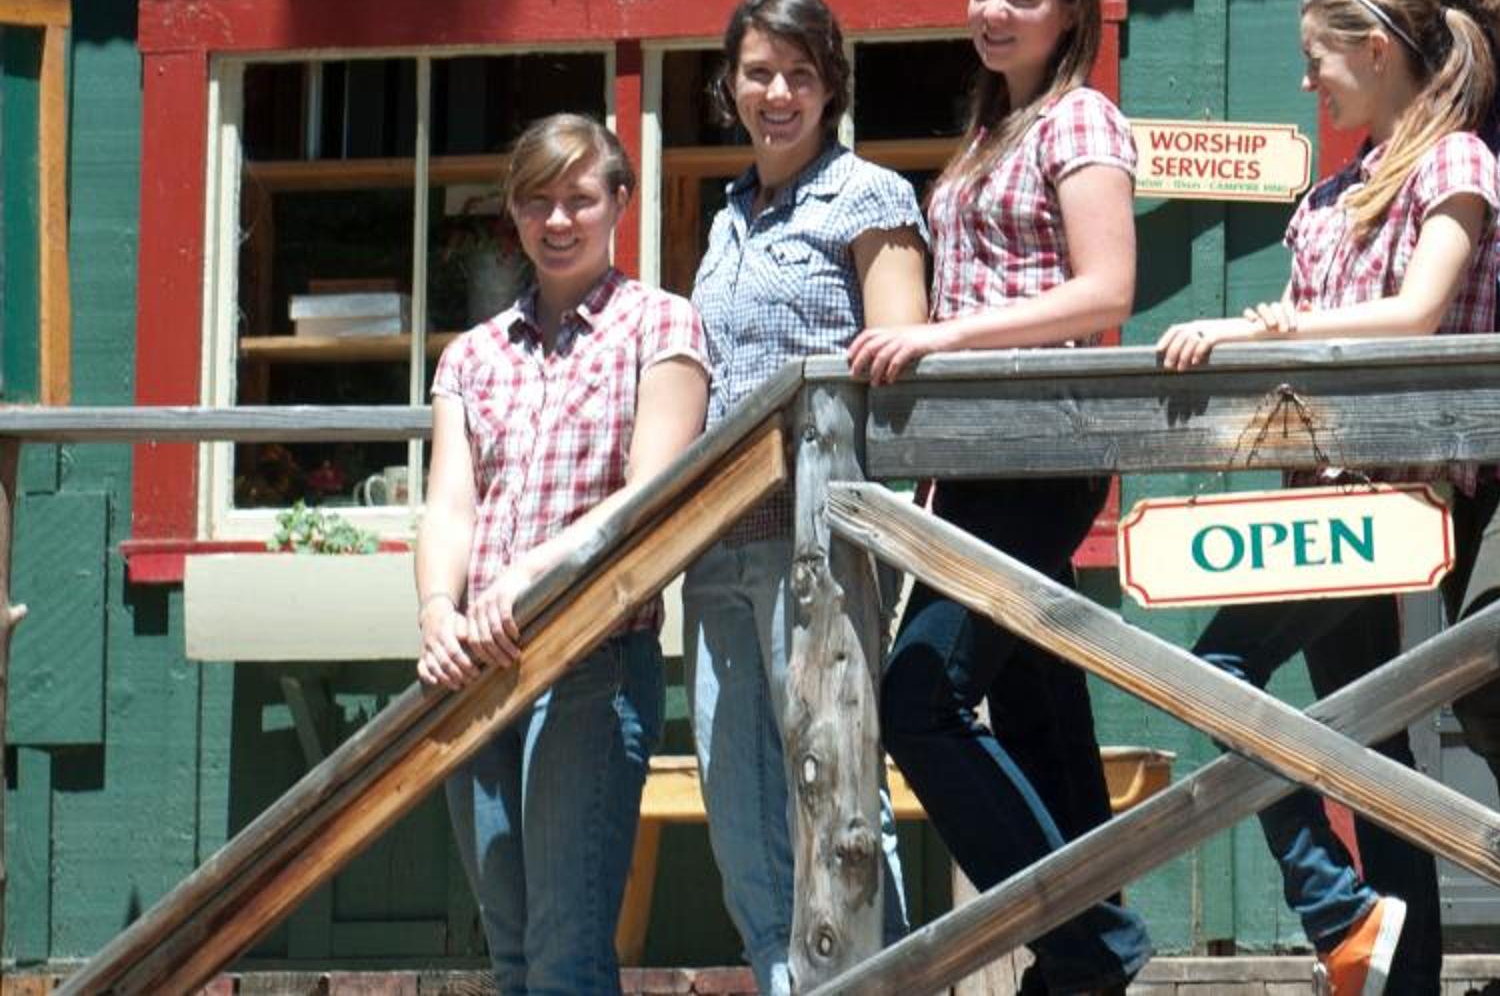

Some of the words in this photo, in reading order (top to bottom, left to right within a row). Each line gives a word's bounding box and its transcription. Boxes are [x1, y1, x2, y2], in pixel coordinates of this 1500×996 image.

[1150, 130, 1268, 155] WORSHIP
[1150, 156, 1261, 180] SERVICES
[1191, 515, 1375, 573] OPEN
